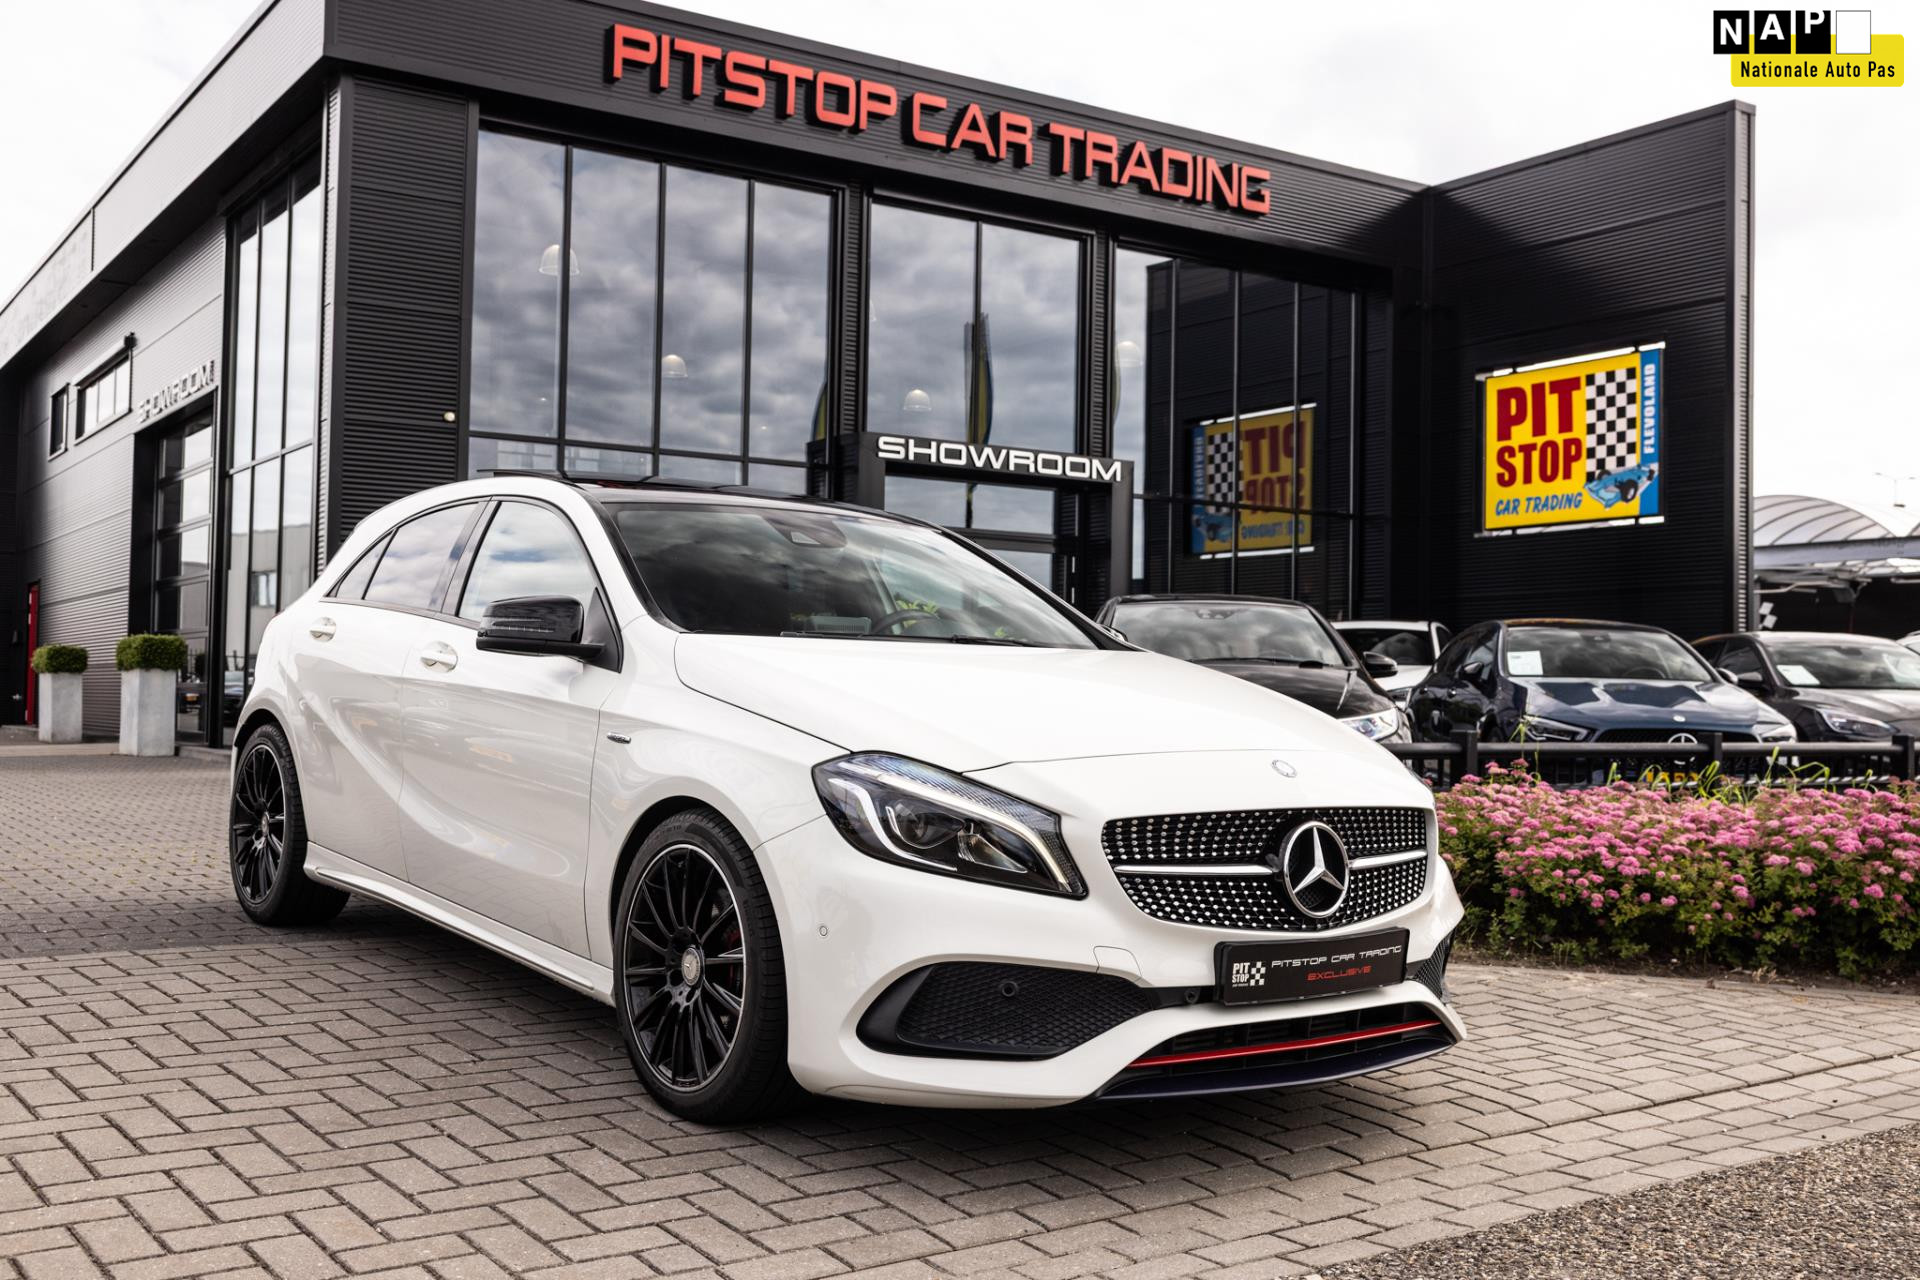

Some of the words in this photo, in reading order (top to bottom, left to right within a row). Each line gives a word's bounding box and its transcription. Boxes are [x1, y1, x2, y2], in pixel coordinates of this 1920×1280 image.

[612, 23, 898, 131] PITSTOP
[911, 92, 1033, 165] CAR
[1048, 121, 1271, 215] TRADING
[1496, 376, 1581, 442] PIT
[1643, 363, 1656, 454] FLEVOLAND
[877, 436, 1122, 482] SHOWROOM
[1496, 437, 1582, 488] STOP
[1495, 498, 1520, 516] CAR
[1525, 492, 1583, 513] TRADING
[1232, 962, 1251, 974] PIT
[1271, 956, 1328, 968] PITSTOP
[1331, 953, 1356, 963] CAR
[1359, 945, 1403, 960] TRADING
[1307, 965, 1372, 981] EXCLUSIVE
[1231, 973, 1250, 984] STOP
